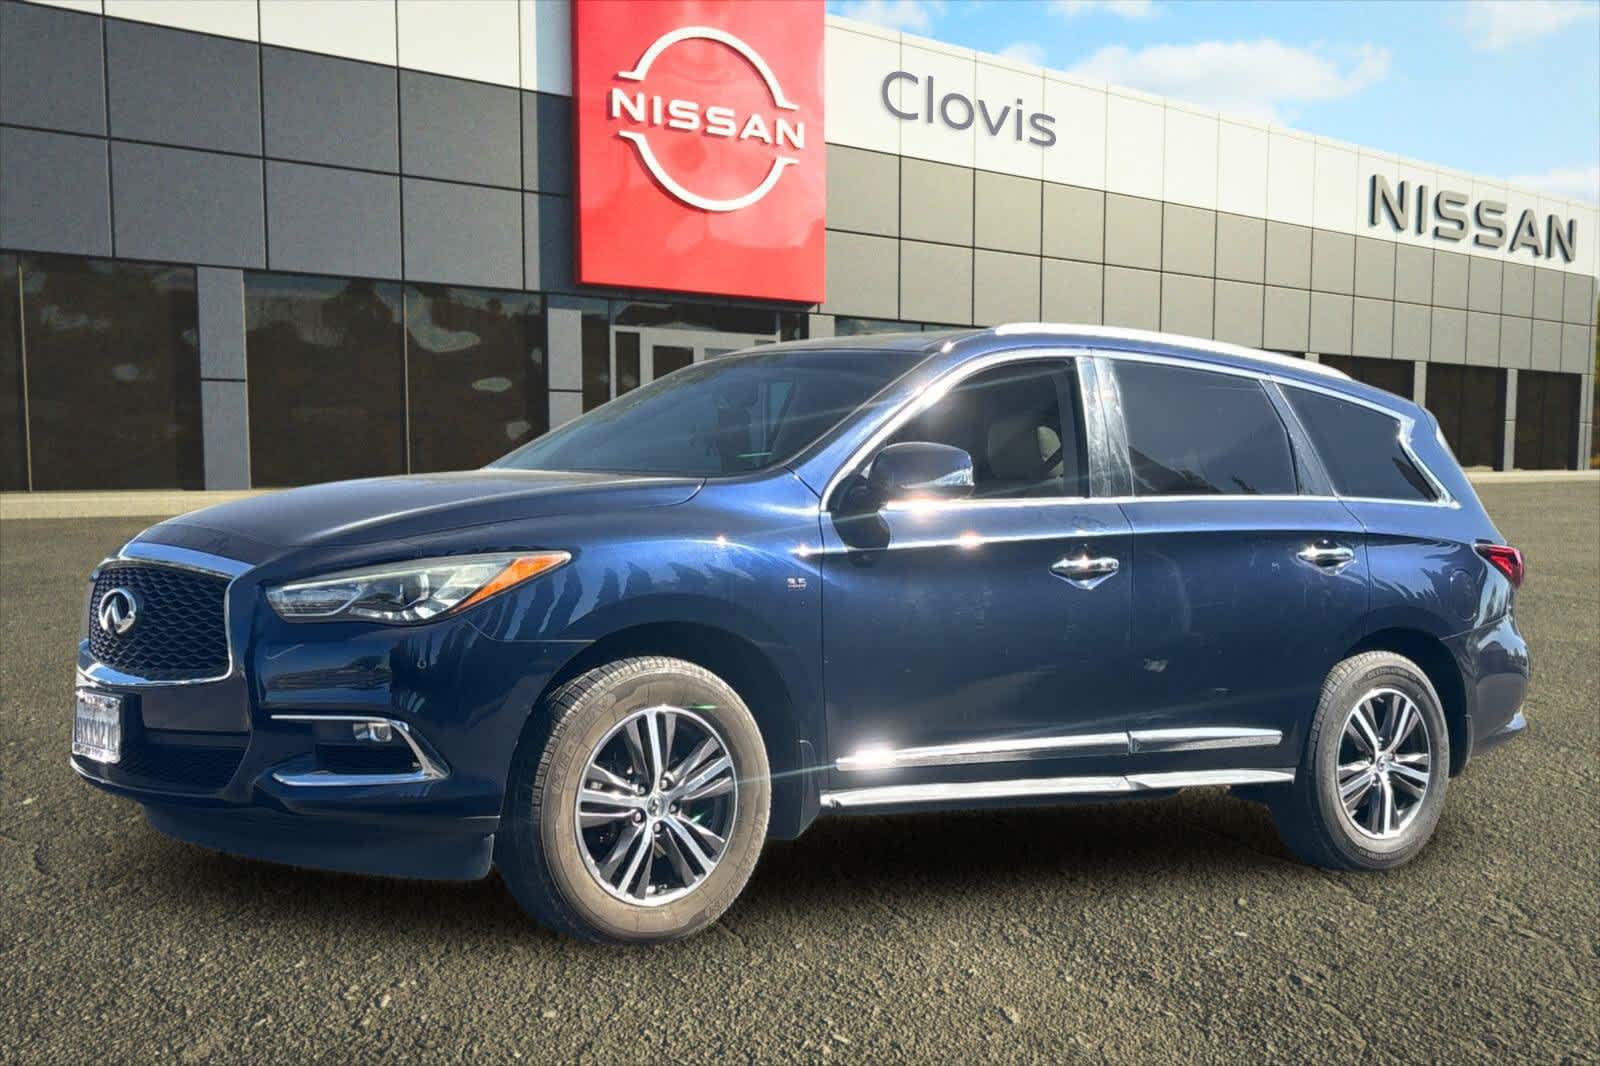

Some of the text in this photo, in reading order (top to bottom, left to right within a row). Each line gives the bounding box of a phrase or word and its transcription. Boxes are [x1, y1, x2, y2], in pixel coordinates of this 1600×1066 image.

[610, 87, 805, 149] NISSAN
[881, 71, 1057, 147] Clovis
[1369, 173, 1578, 264] NISSAN
